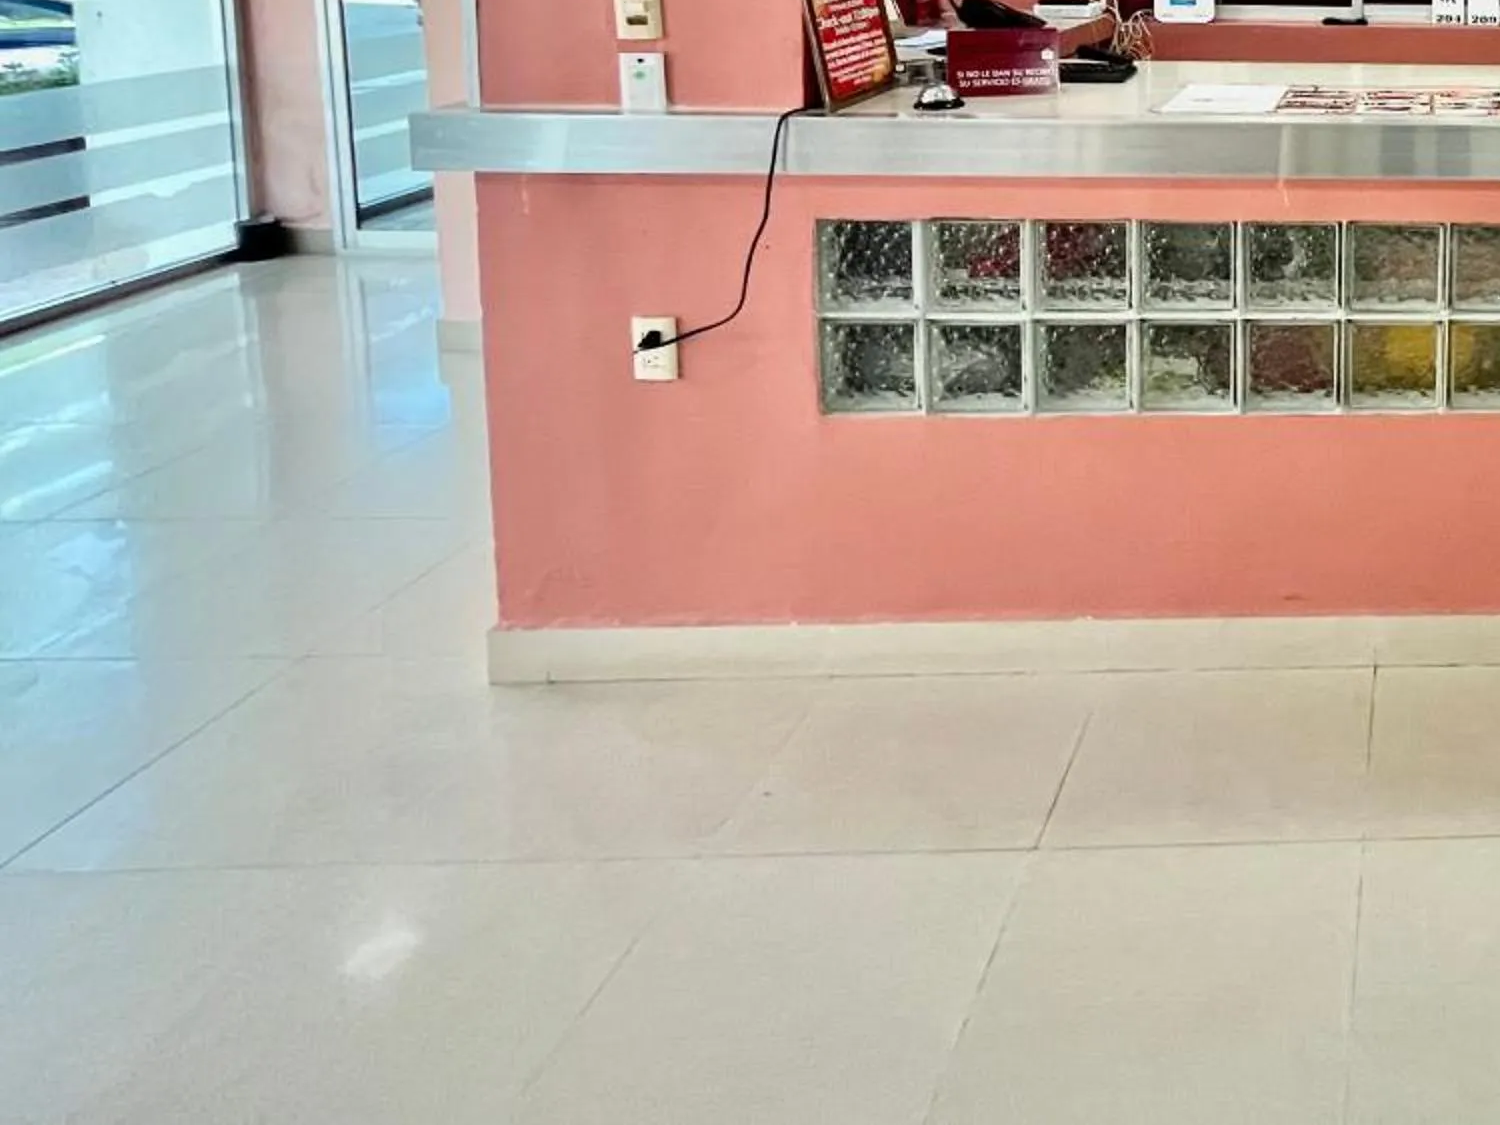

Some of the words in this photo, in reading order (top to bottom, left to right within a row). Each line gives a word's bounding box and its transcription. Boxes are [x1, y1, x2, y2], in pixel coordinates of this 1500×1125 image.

[966, 70, 979, 78] NO
[959, 80, 970, 88] SU
[972, 79, 1010, 87] SERVICIO
[1011, 78, 1021, 86] ES
